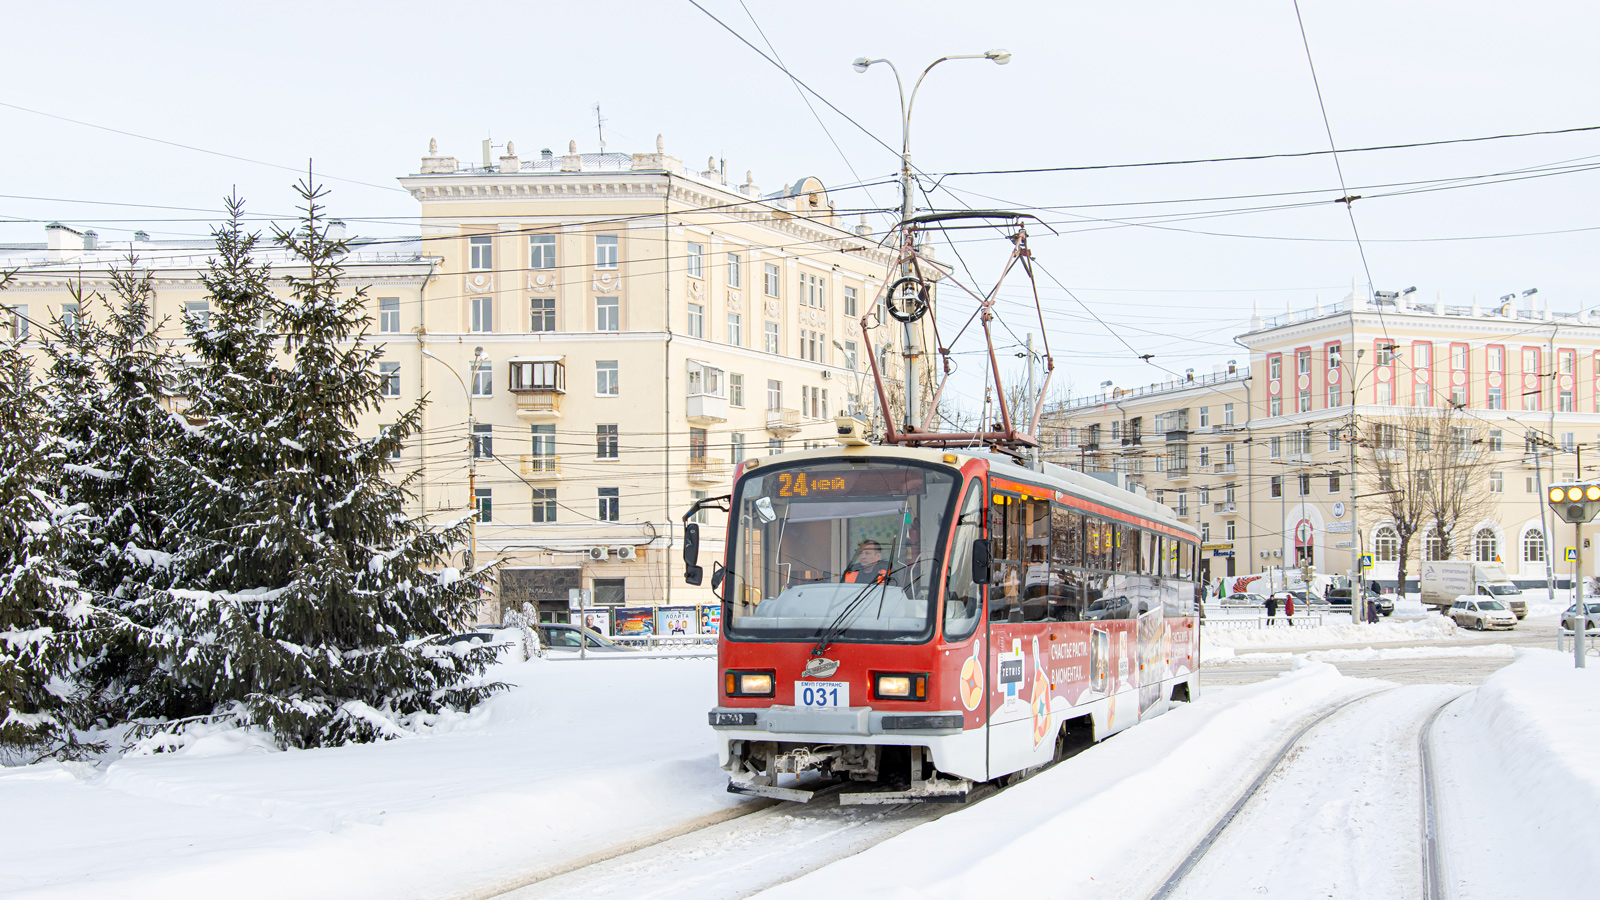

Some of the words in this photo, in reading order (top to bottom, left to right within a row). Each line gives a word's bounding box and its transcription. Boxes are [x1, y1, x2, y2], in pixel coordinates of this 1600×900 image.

[779, 473, 808, 497] 24
[1051, 643, 1072, 660] СЧАСТЬЕ
[1002, 667, 1021, 677] TETRIS
[1051, 669, 1055, 684] В
[803, 688, 838, 706] 031
